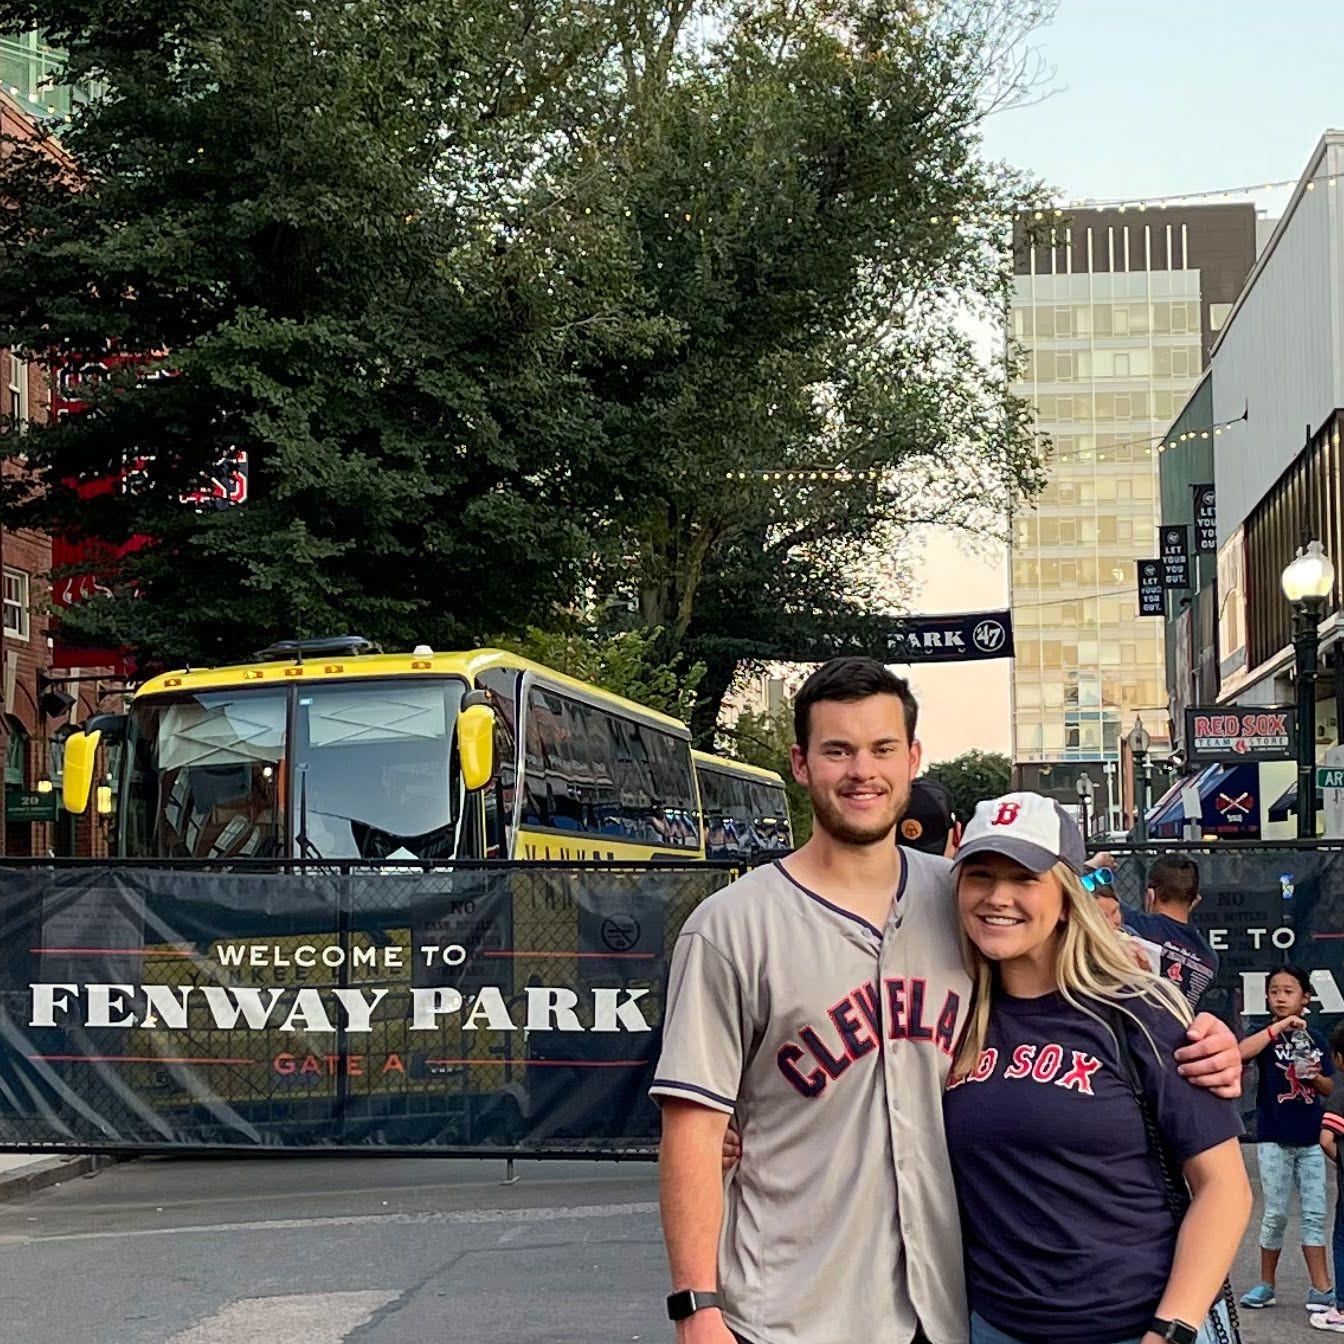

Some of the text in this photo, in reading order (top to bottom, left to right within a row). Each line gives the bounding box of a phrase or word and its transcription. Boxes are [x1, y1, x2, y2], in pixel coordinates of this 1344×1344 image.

[1197, 518, 1216, 527] YOU
[1201, 529, 1216, 538] YO
[1165, 545, 1182, 554] LET
[1200, 540, 1216, 549] OU
[1162, 556, 1187, 565] YOUR
[1165, 565, 1185, 574] YOU
[1142, 577, 1159, 587] LET
[1194, 713, 1288, 738] RED SOX
[1198, 737, 1285, 747] TEAM STORE
[21, 796, 40, 806] 20
[991, 802, 1022, 826] B
[1247, 927, 1296, 949] TO
[217, 944, 466, 967] WELCOME TO
[28, 983, 653, 1033] FENWAY PARK
[776, 976, 961, 1099] CLEVELA
[272, 1052, 363, 1076] GATE
[381, 1053, 405, 1074] A
[1004, 1043, 1103, 1096] SOX
